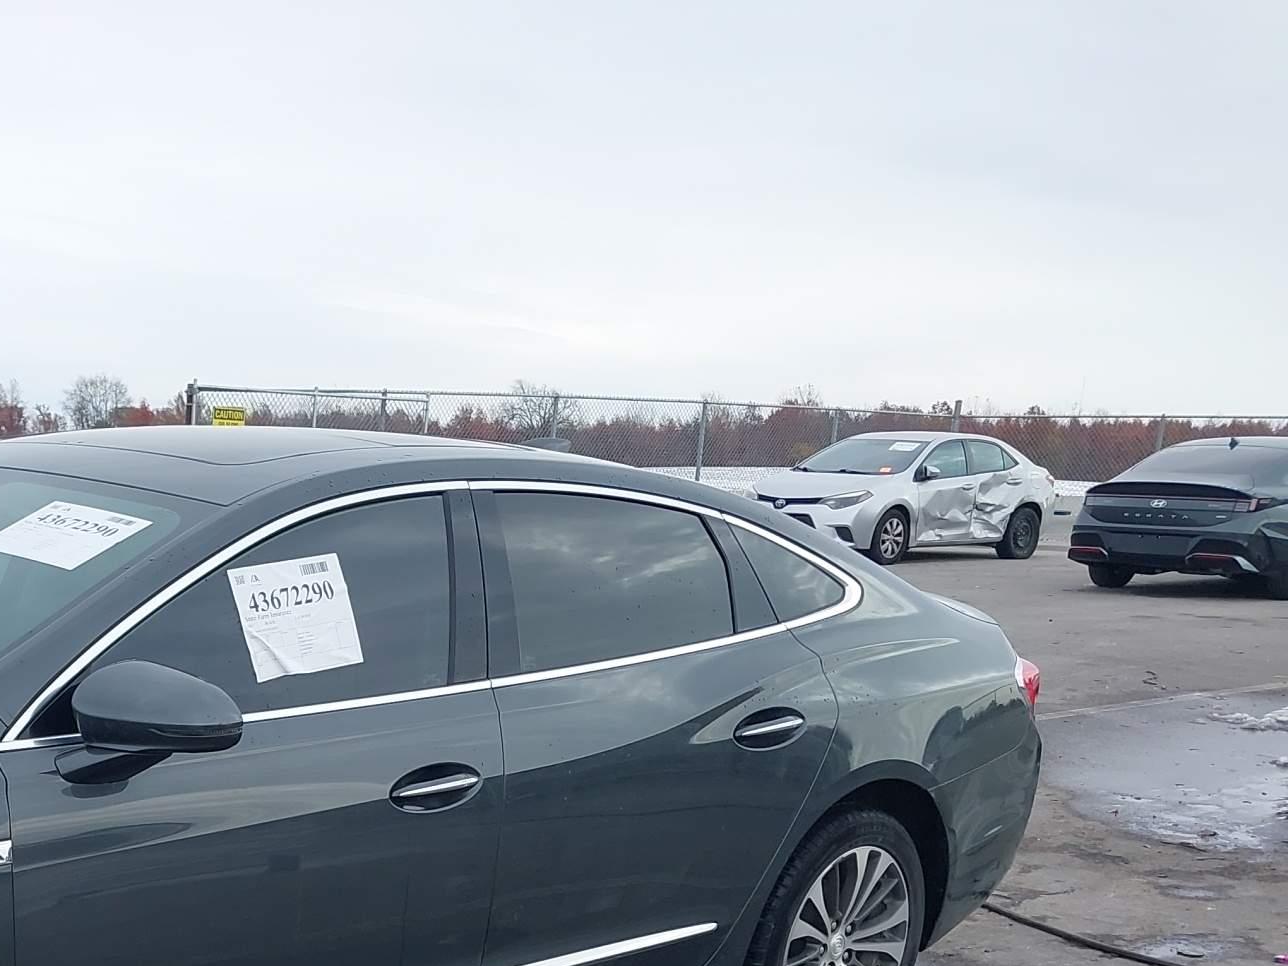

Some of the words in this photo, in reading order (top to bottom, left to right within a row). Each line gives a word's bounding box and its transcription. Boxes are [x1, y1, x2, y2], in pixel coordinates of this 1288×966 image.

[215, 409, 243, 420] CAUTION
[37, 513, 120, 537] 43672290
[249, 580, 334, 612] 43672290
